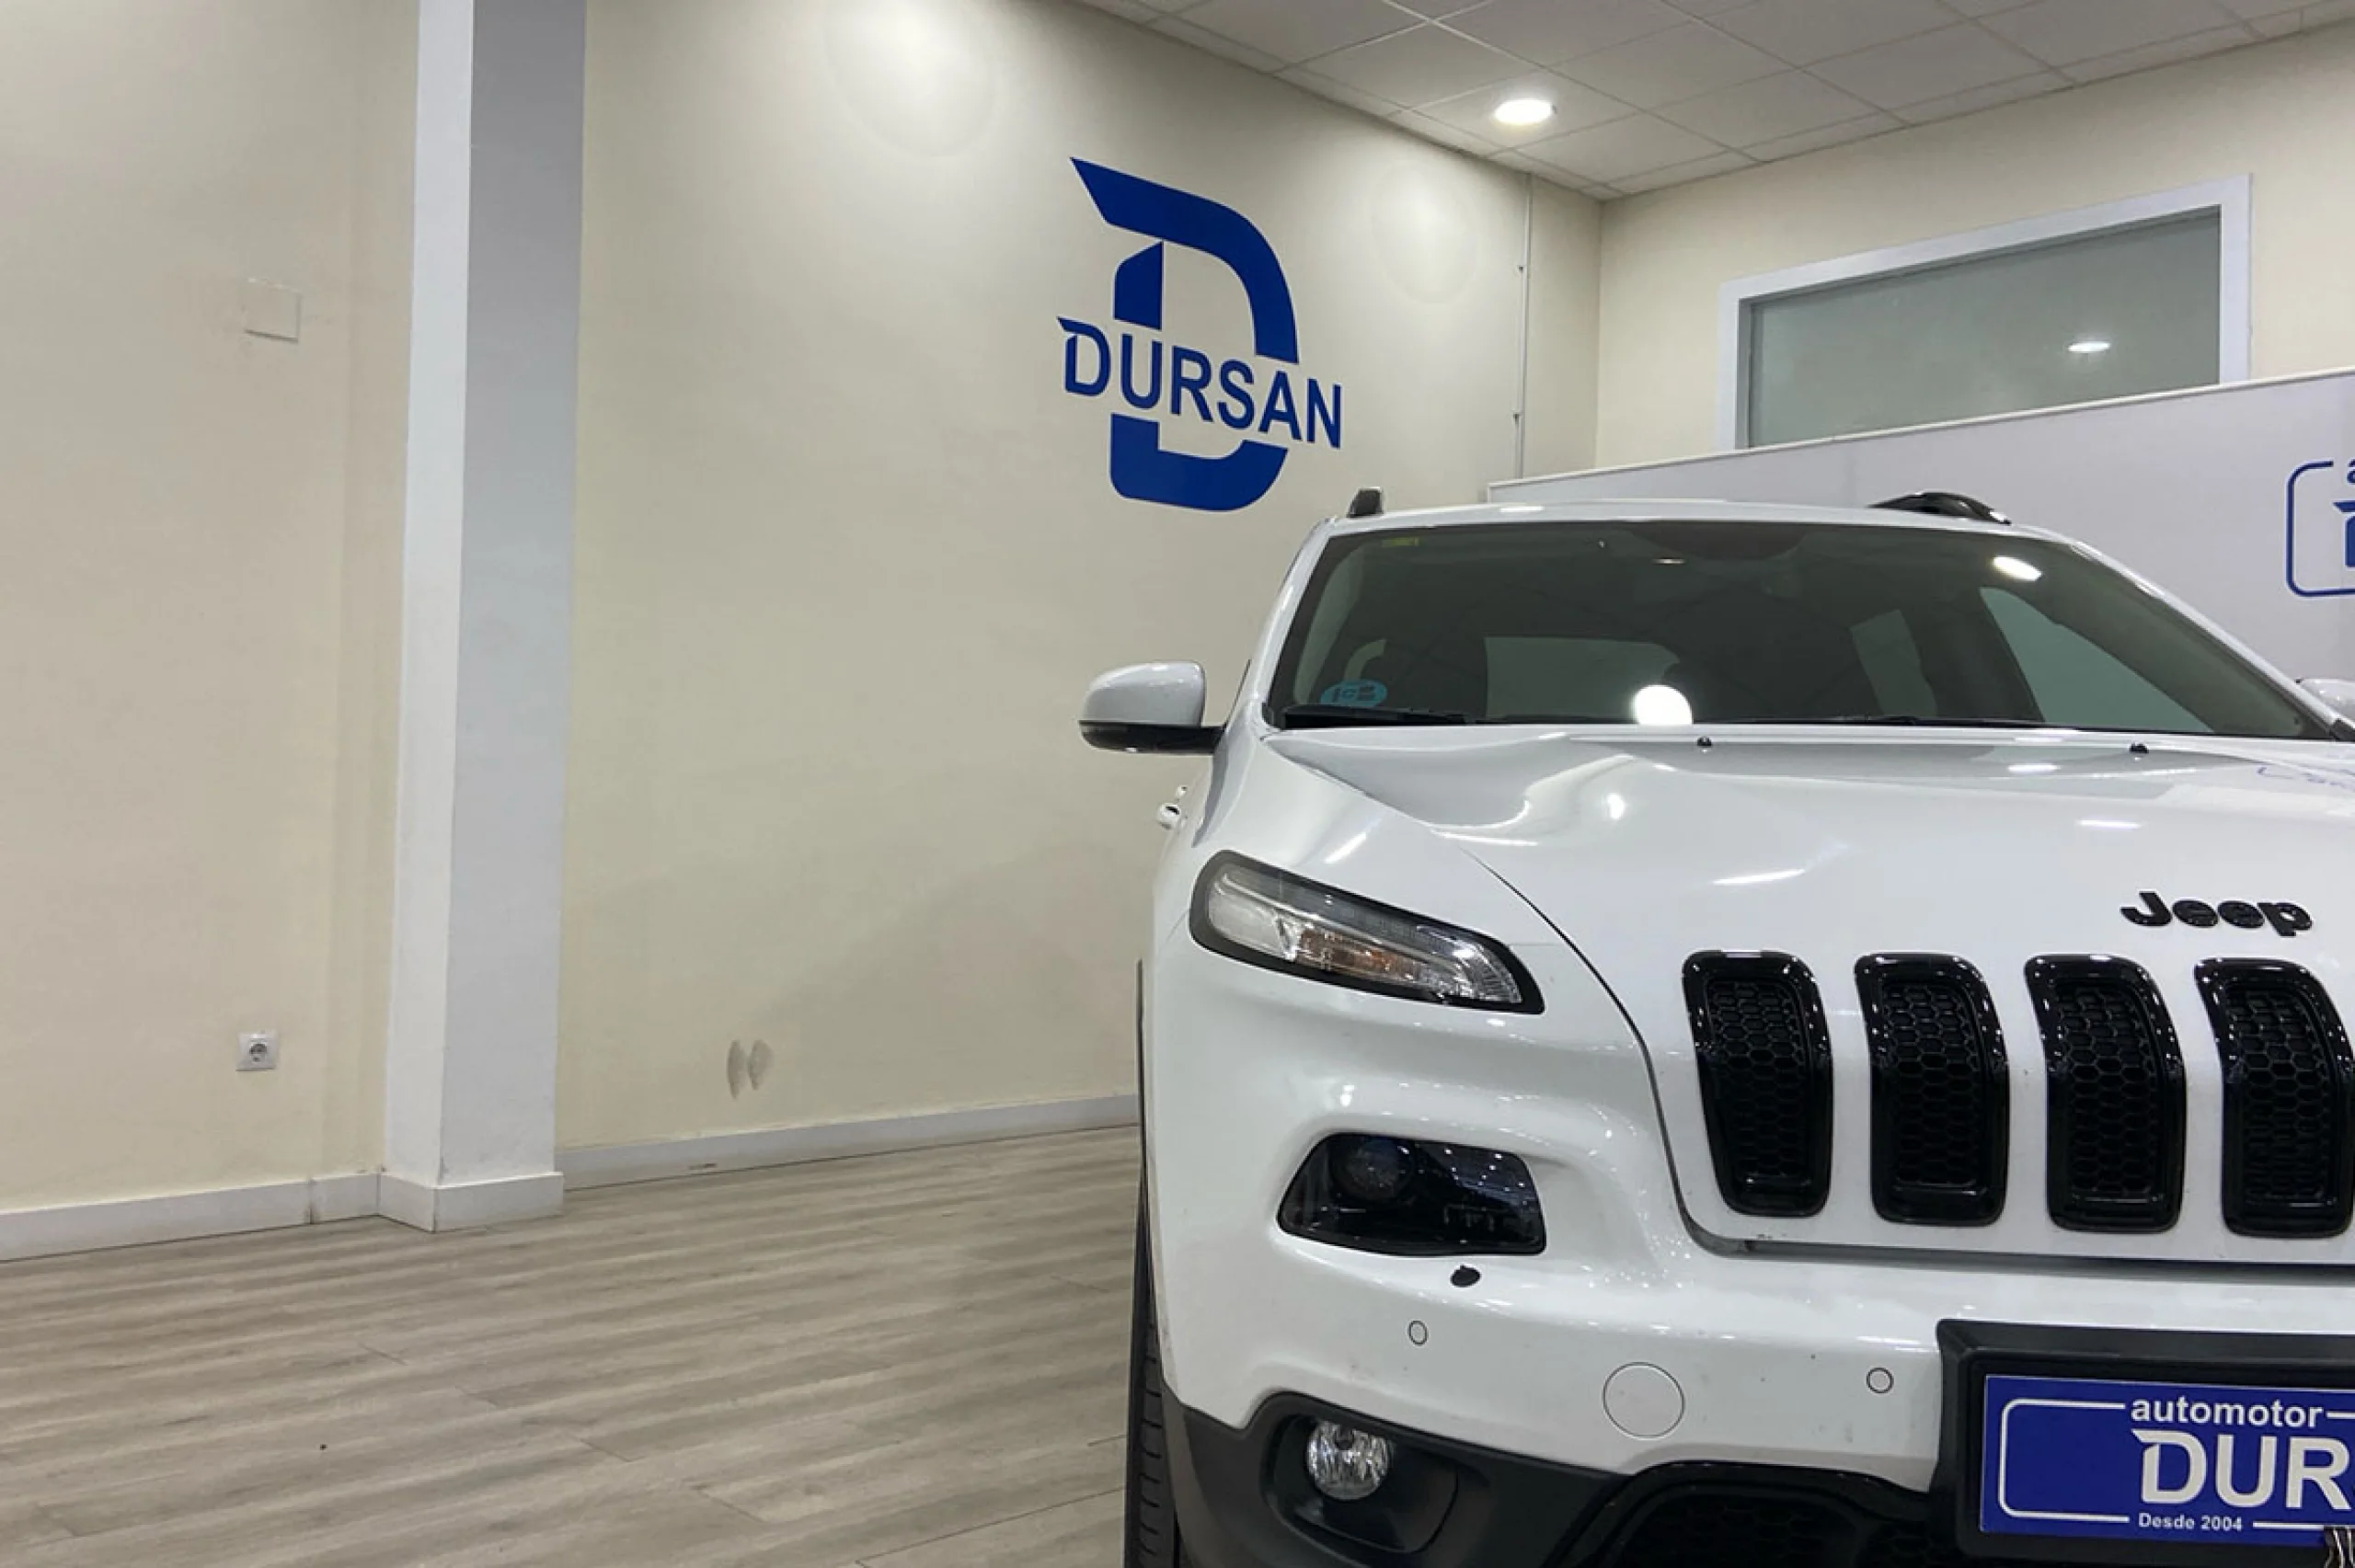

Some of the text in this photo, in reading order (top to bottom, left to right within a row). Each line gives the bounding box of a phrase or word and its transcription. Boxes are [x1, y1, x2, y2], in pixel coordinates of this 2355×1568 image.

[1057, 316, 1342, 450] DURSAN
[2120, 890, 2313, 937] Jeep
[2131, 1396, 2324, 1428] automotor
[2138, 1512, 2243, 1531] Desde 2004
